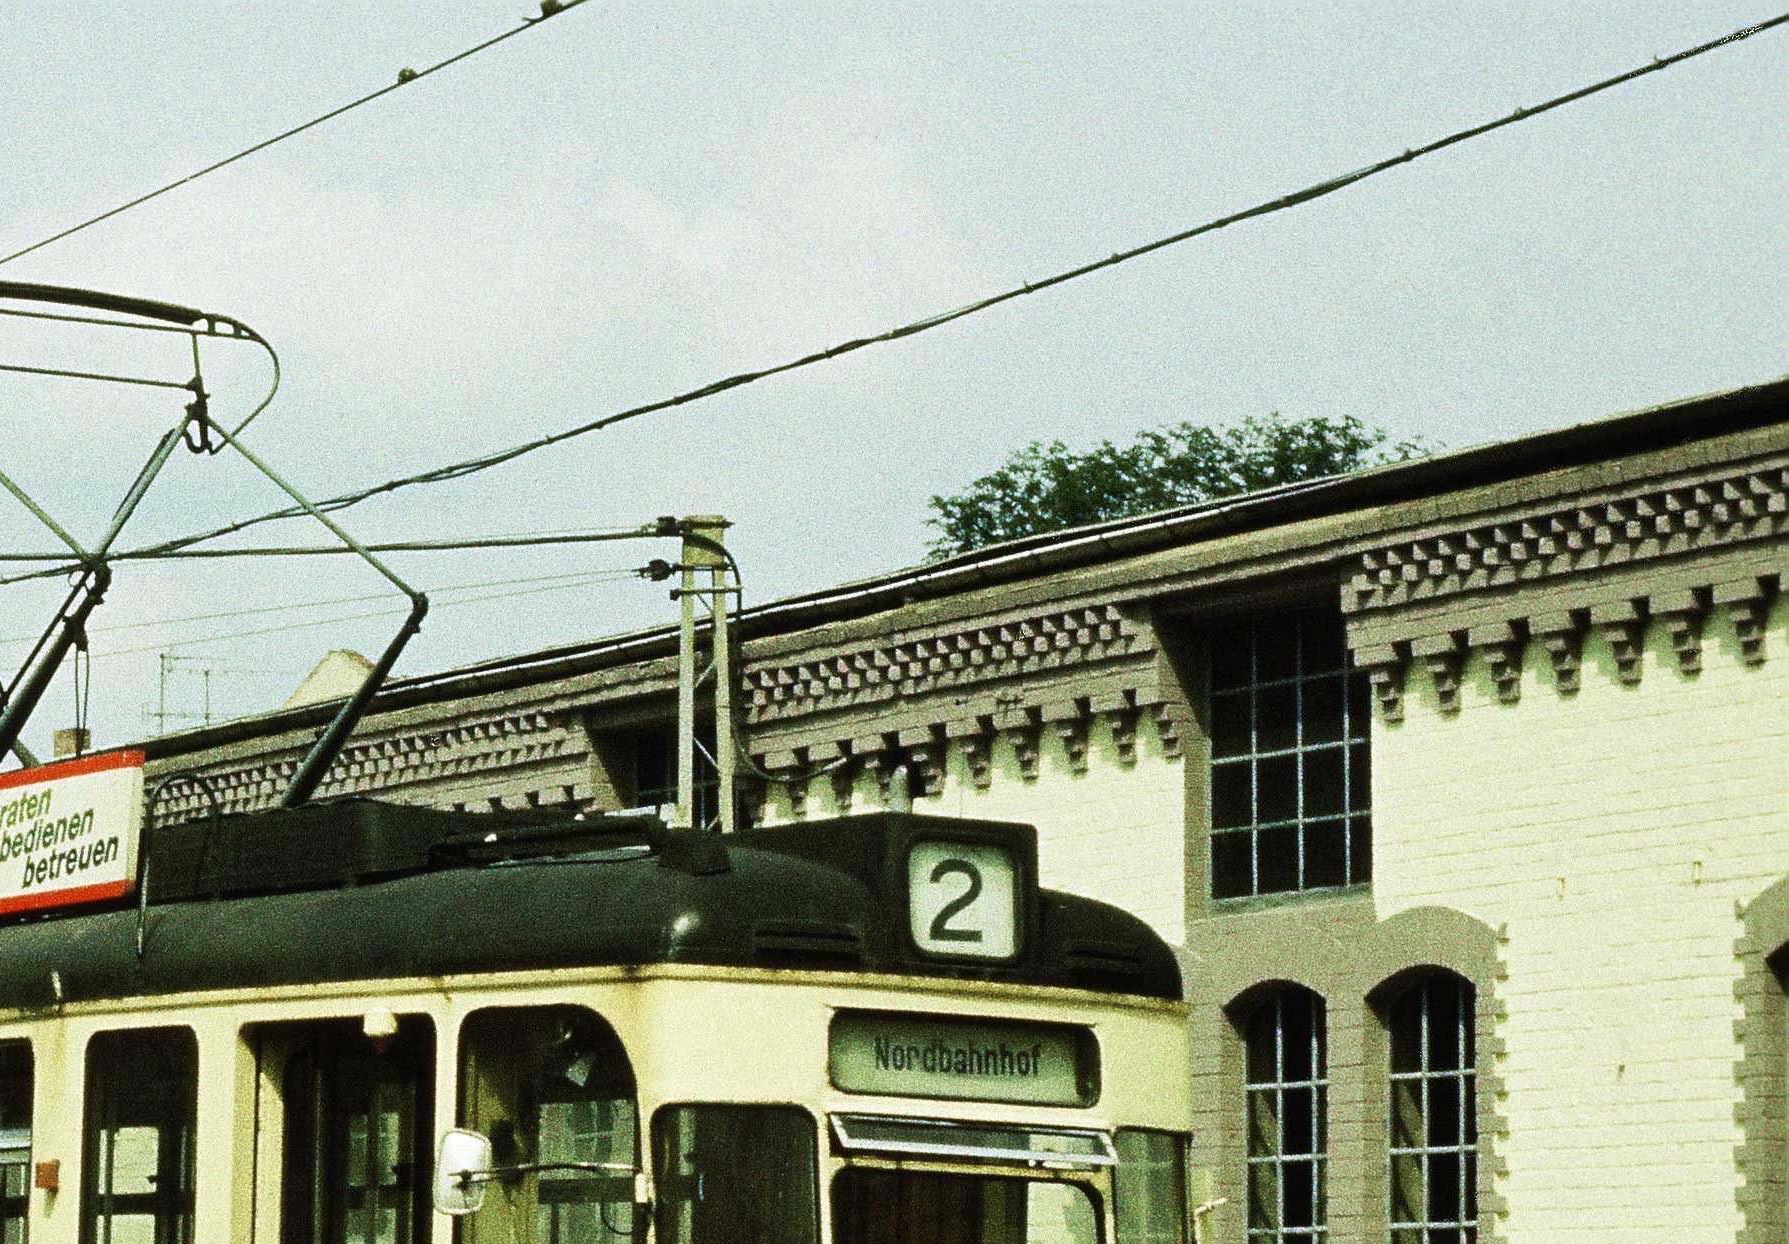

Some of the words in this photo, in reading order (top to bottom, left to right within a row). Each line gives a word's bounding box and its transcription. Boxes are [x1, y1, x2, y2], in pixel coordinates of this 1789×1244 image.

[22, 835, 119, 889] betreuen
[929, 858, 983, 943] 2
[873, 1035, 1042, 1077] Nordbahnhof
